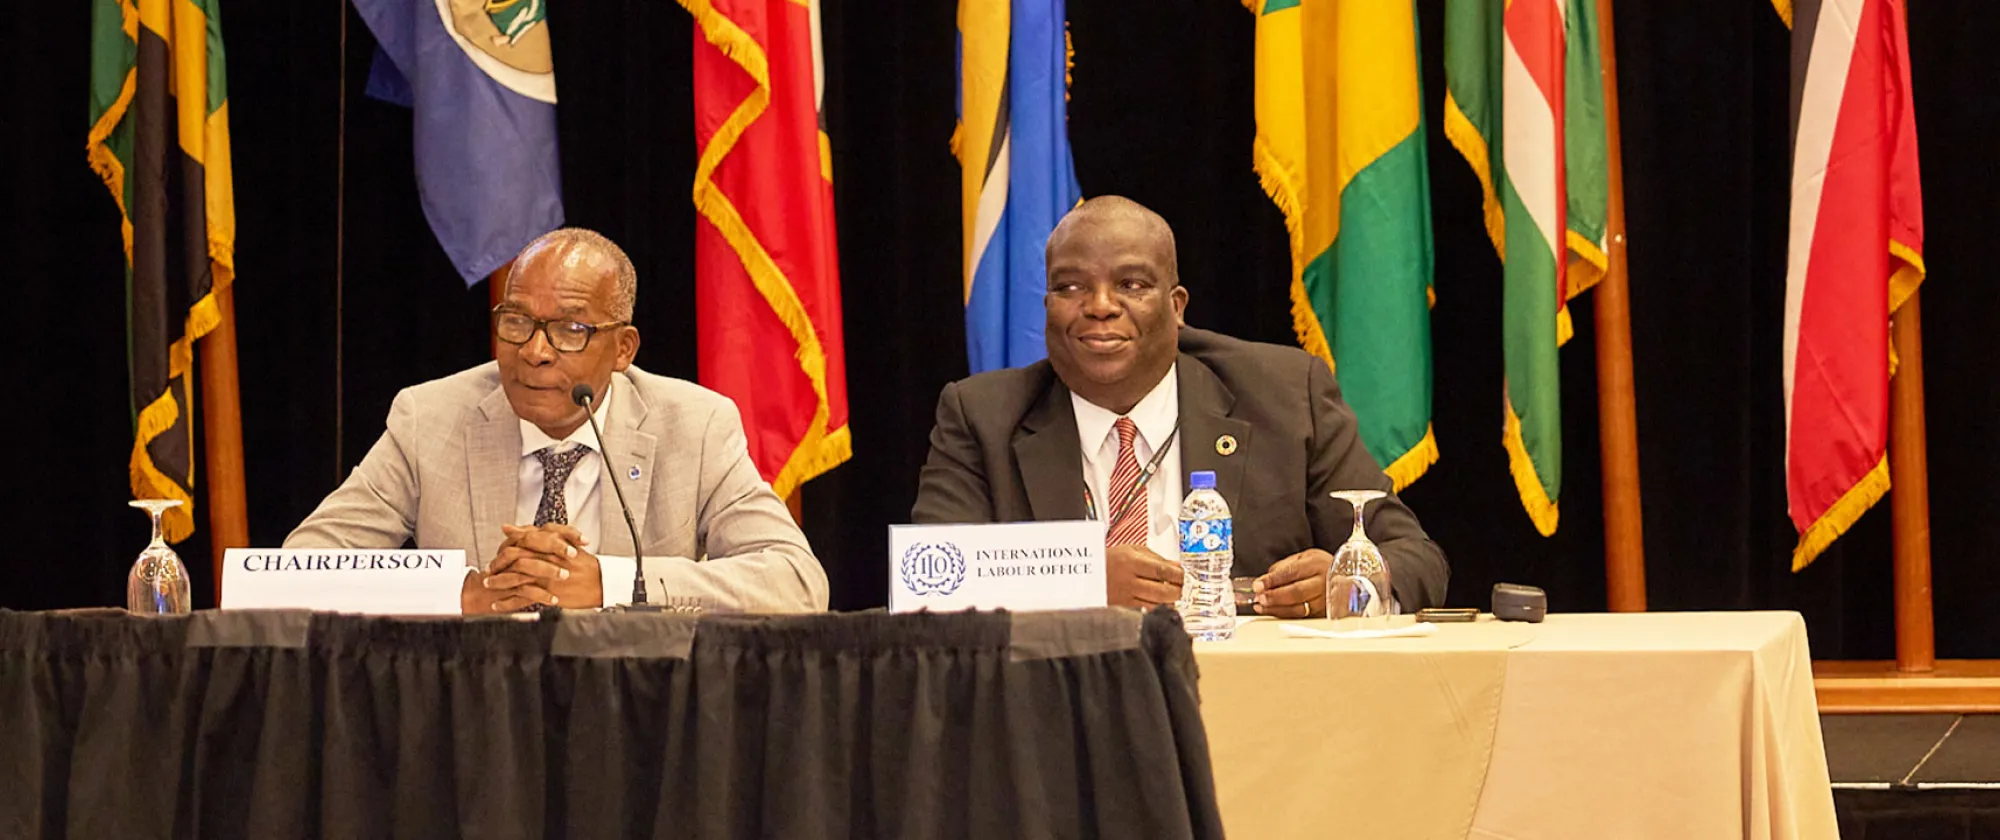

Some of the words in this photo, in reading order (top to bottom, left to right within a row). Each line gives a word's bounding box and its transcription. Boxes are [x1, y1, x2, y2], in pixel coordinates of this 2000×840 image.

[976, 547, 1093, 561] INTERNATIONAL
[243, 554, 444, 572] CHAIRPERSON
[921, 553, 947, 579] ILO
[977, 565, 1036, 578] LABOUR
[1039, 563, 1093, 576] OFFICE
